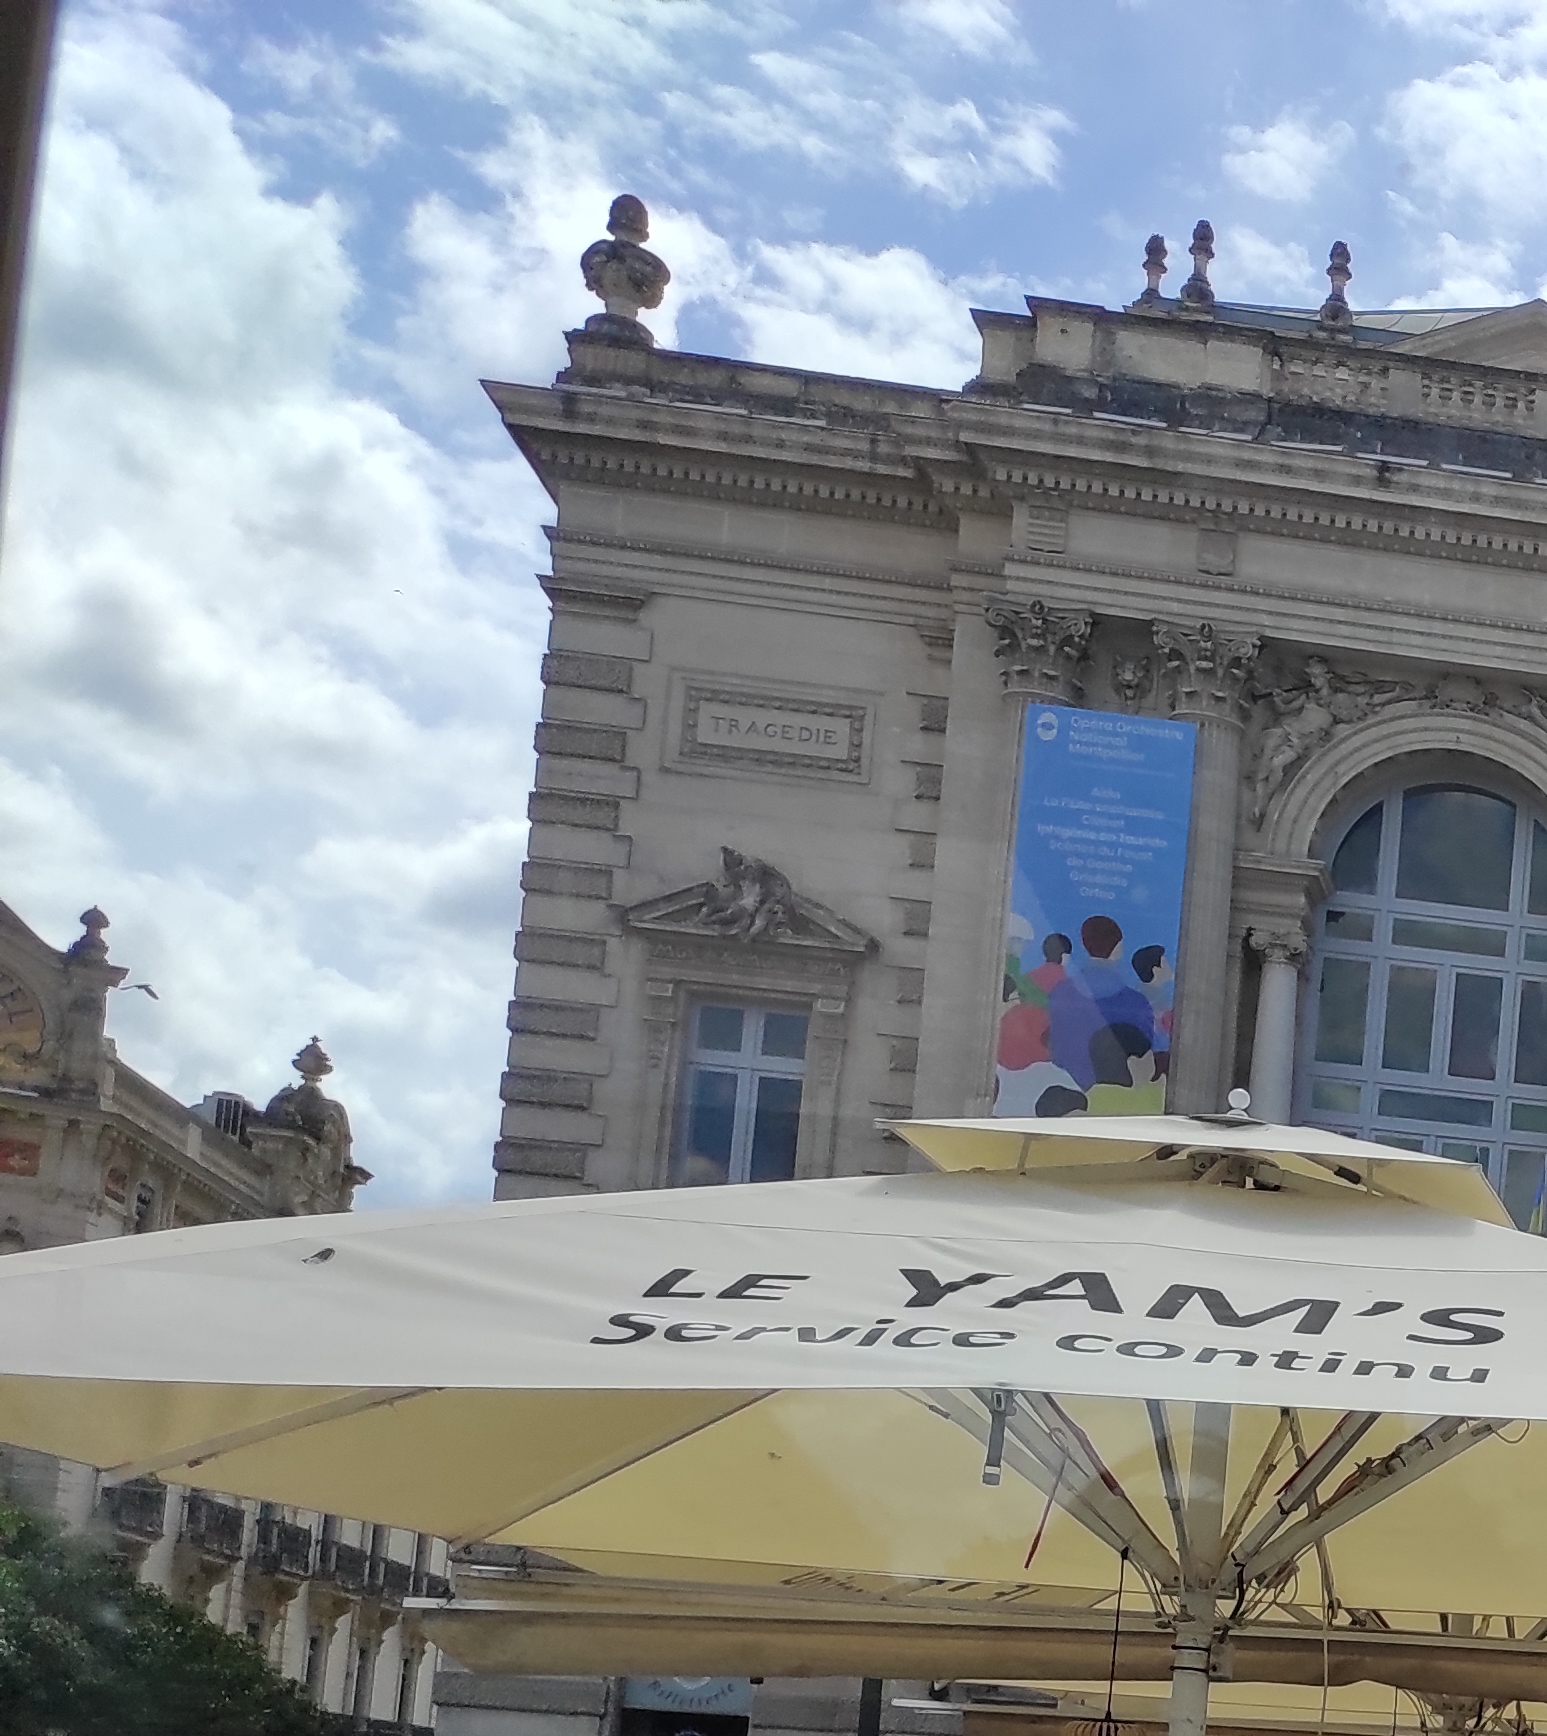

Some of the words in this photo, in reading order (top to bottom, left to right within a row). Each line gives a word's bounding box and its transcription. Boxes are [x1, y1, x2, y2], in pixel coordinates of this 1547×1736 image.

[709, 714, 839, 746] TRAGEDIE
[642, 1268, 810, 1300] LE
[897, 1268, 1506, 1346] YAM'S
[590, 1311, 1018, 1349] Service
[1056, 1333, 1492, 1384] continu
